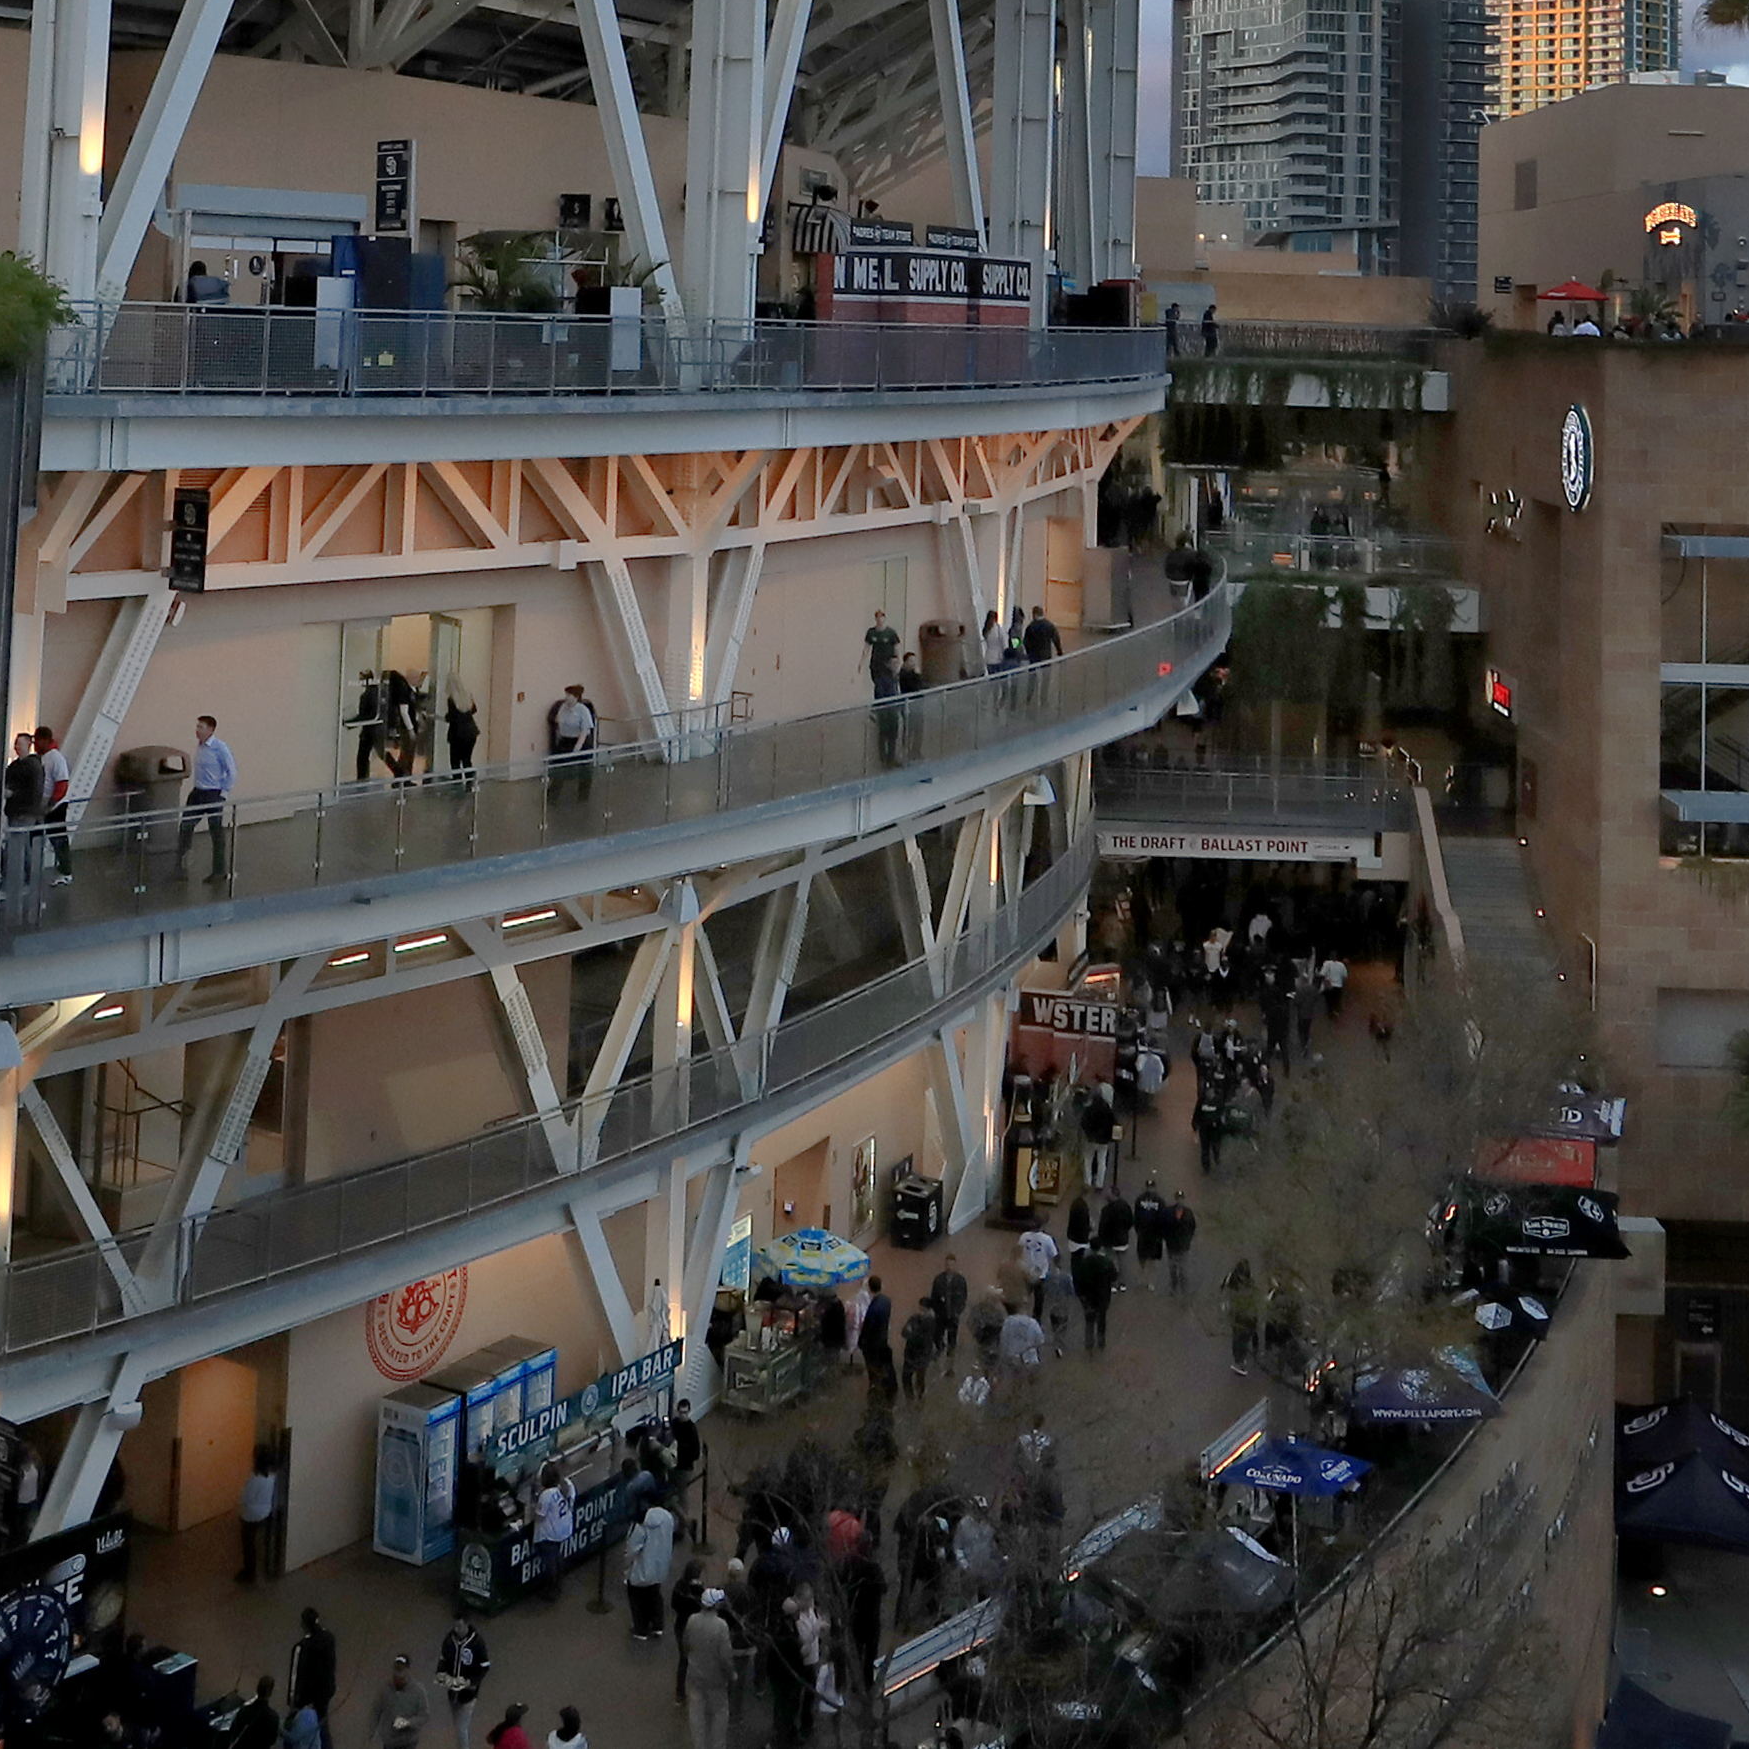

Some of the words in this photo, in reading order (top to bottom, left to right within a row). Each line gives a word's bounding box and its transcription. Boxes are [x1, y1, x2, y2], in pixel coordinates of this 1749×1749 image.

[882, 229, 895, 241] TEAM
[908, 258, 949, 292] SUPPLY
[951, 261, 968, 293] CO.
[982, 264, 1015, 296] SUPPLY
[1111, 835, 1136, 849] THE
[1140, 836, 1186, 850] DRAFT
[1201, 838, 1262, 852] BALLAST
[1267, 840, 1309, 853] POINT
[378, 1321, 409, 1364] DEDICATED
[411, 1349, 423, 1362] TO
[424, 1334, 440, 1354] THE
[497, 1401, 568, 1458] SCULPIN
[611, 1370, 637, 1398] IPA
[641, 1347, 674, 1382] BAR
[575, 1488, 617, 1530] POINT
